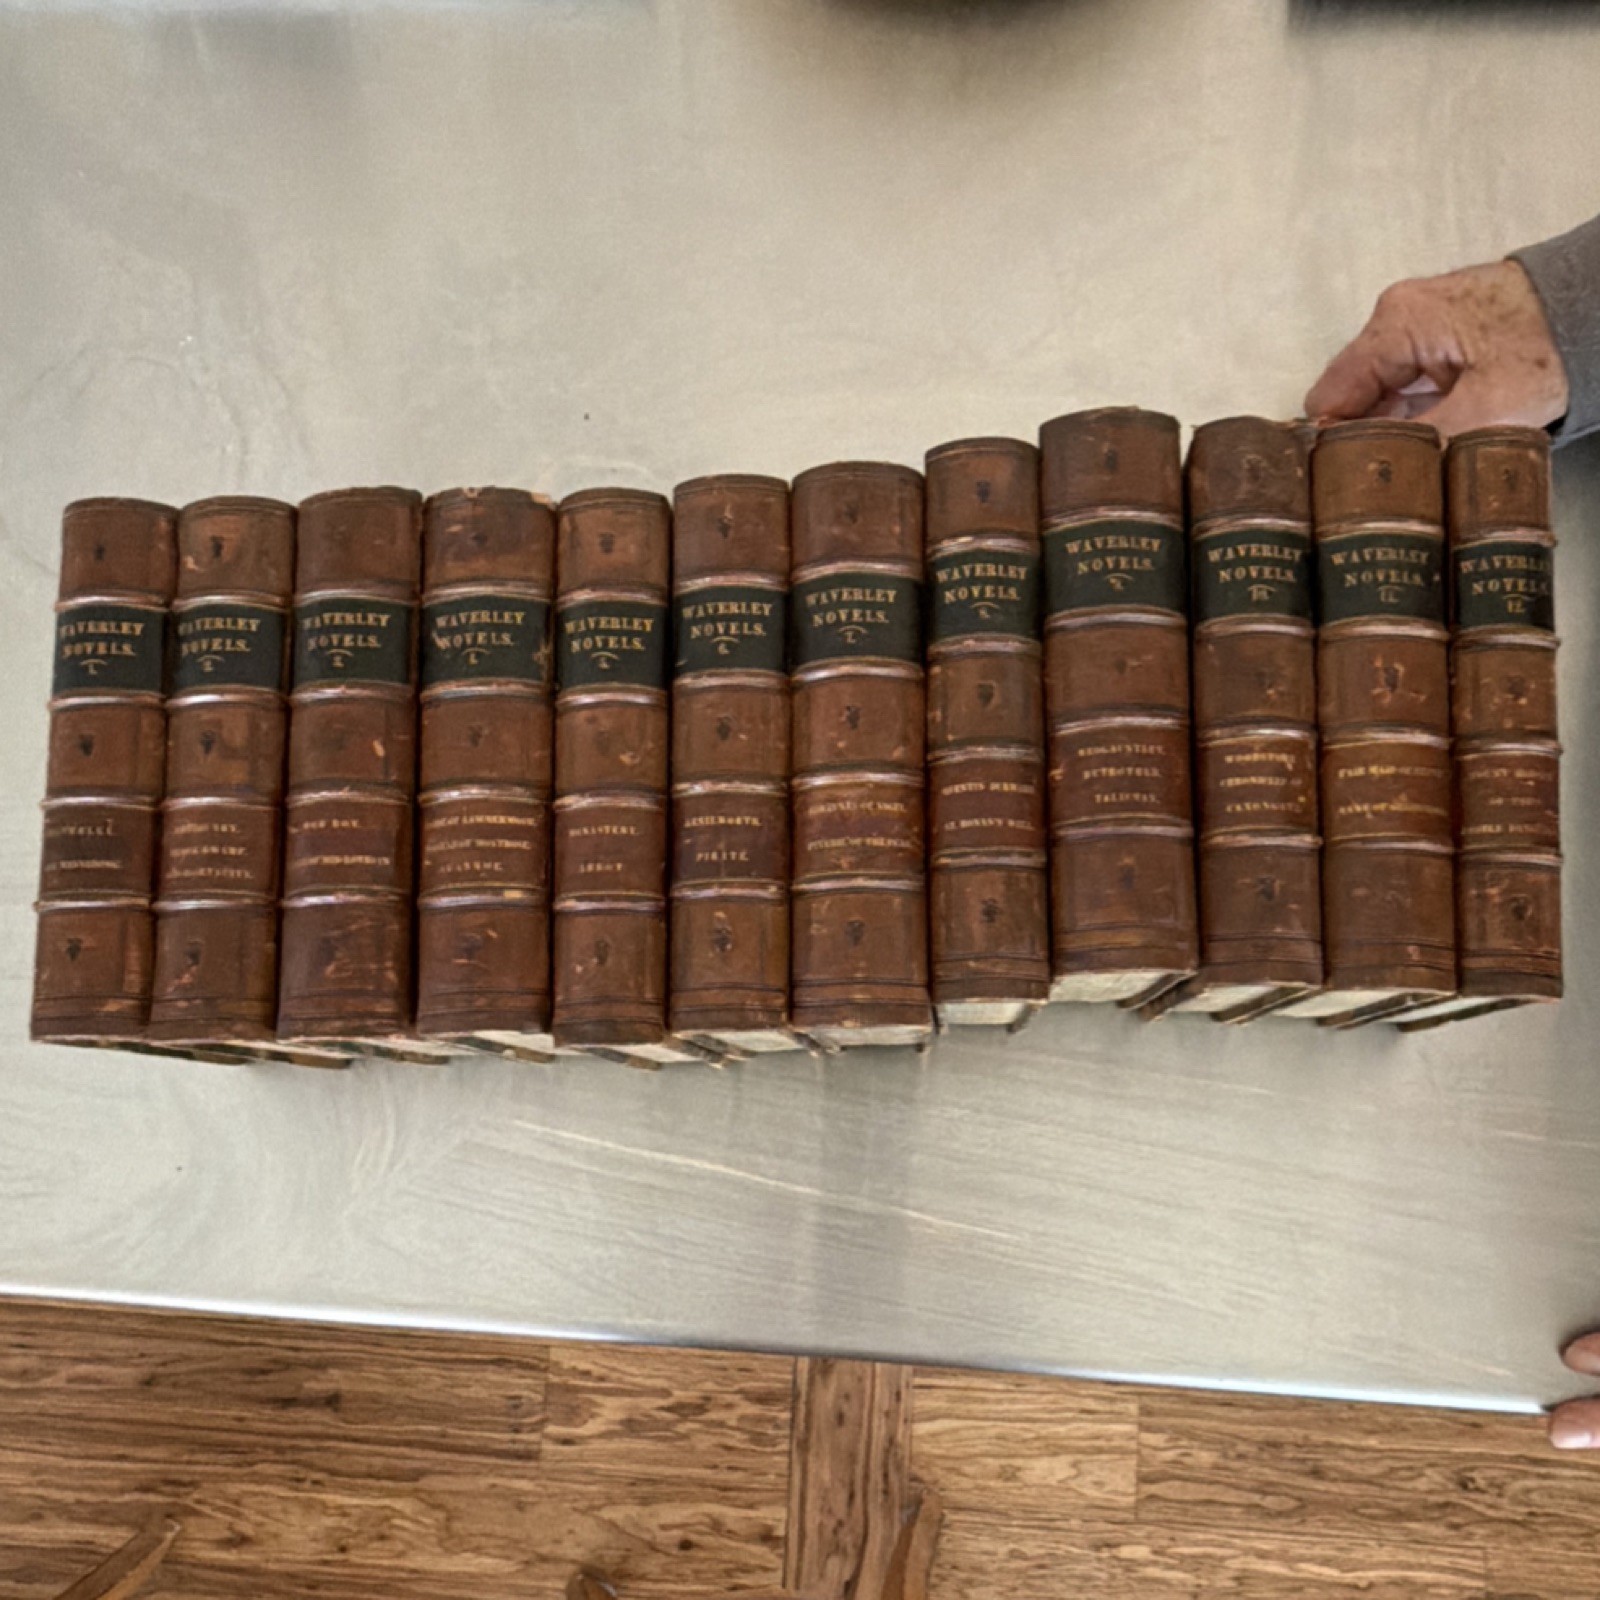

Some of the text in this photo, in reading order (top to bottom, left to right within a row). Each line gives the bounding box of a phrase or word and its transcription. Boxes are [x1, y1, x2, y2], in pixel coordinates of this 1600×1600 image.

[1065, 535, 1161, 554] WAVERLEY
[1208, 543, 1303, 564] WAVERLEY
[1330, 546, 1430, 566] WAVERLEY
[935, 562, 1028, 583] WAVERLEY
[805, 587, 897, 607] WAVERLEY
[435, 610, 526, 629] WAVERLEY
[682, 601, 773, 619] WAVERLEY
[565, 616, 655, 634] WAVERLEY
